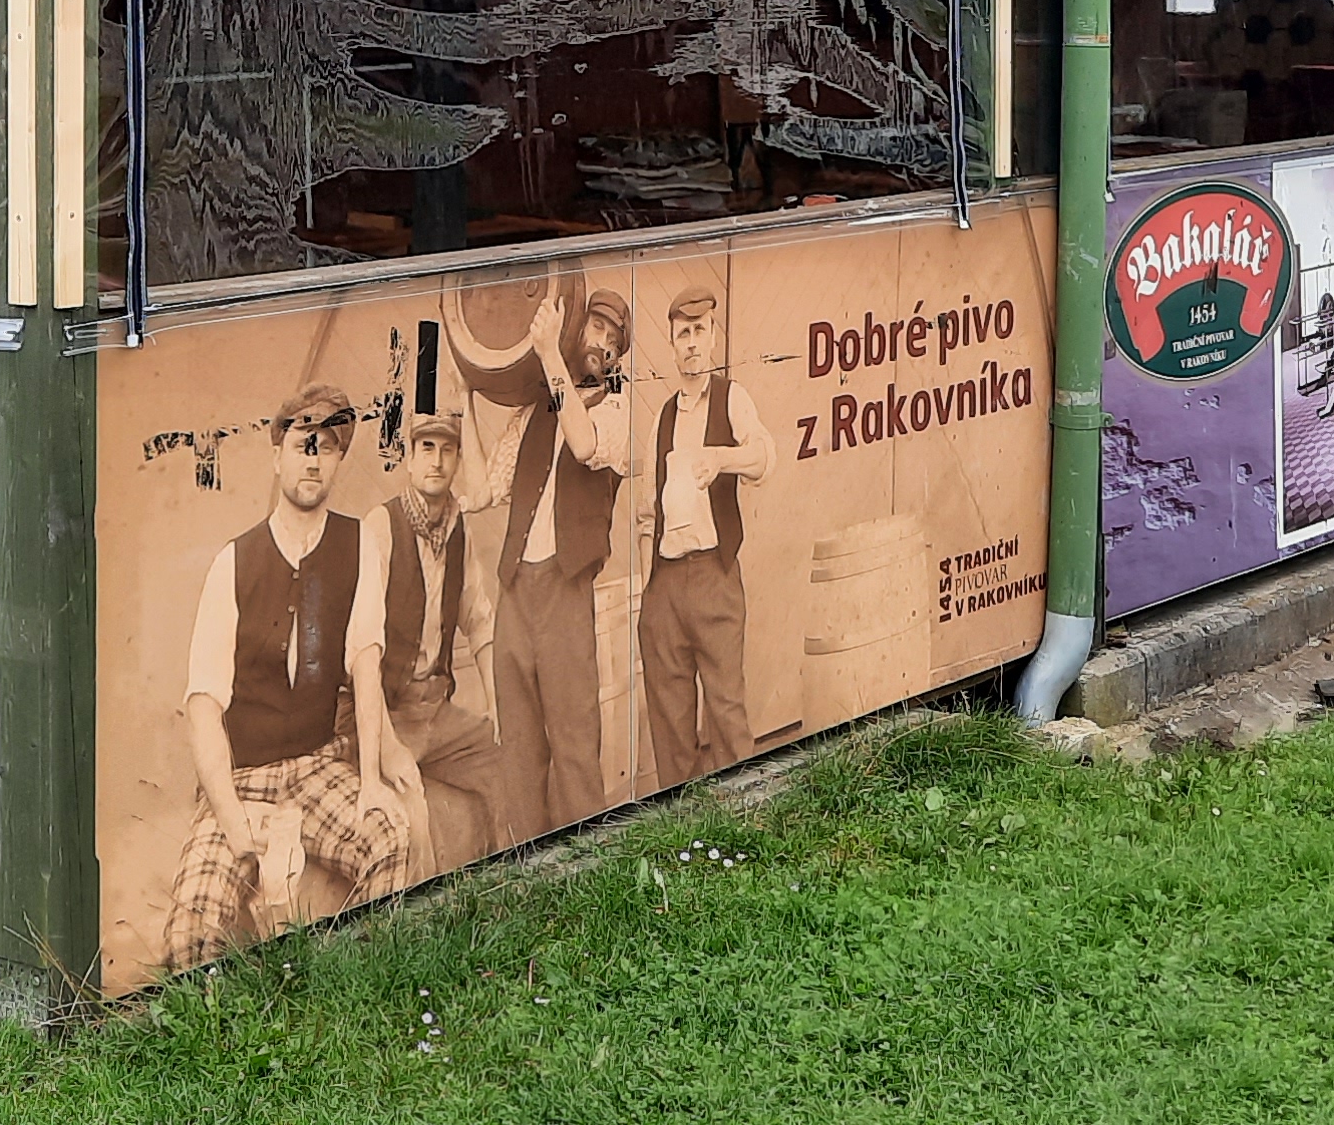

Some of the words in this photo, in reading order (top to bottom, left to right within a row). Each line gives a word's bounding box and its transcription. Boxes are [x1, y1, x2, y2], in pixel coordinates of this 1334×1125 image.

[1126, 208, 1273, 303] Bakalář
[1189, 303, 1217, 325] 1454
[807, 300, 927, 379] Dobré
[938, 295, 1014, 365] pivo
[796, 415, 818, 460] z
[831, 361, 1032, 452] Rakovníka
[955, 534, 1018, 573] TRADIČNÍ
[955, 564, 1008, 596] PIVOVAR
[955, 598, 964, 616] V
[968, 573, 1047, 614] RAKOVNÍKU
